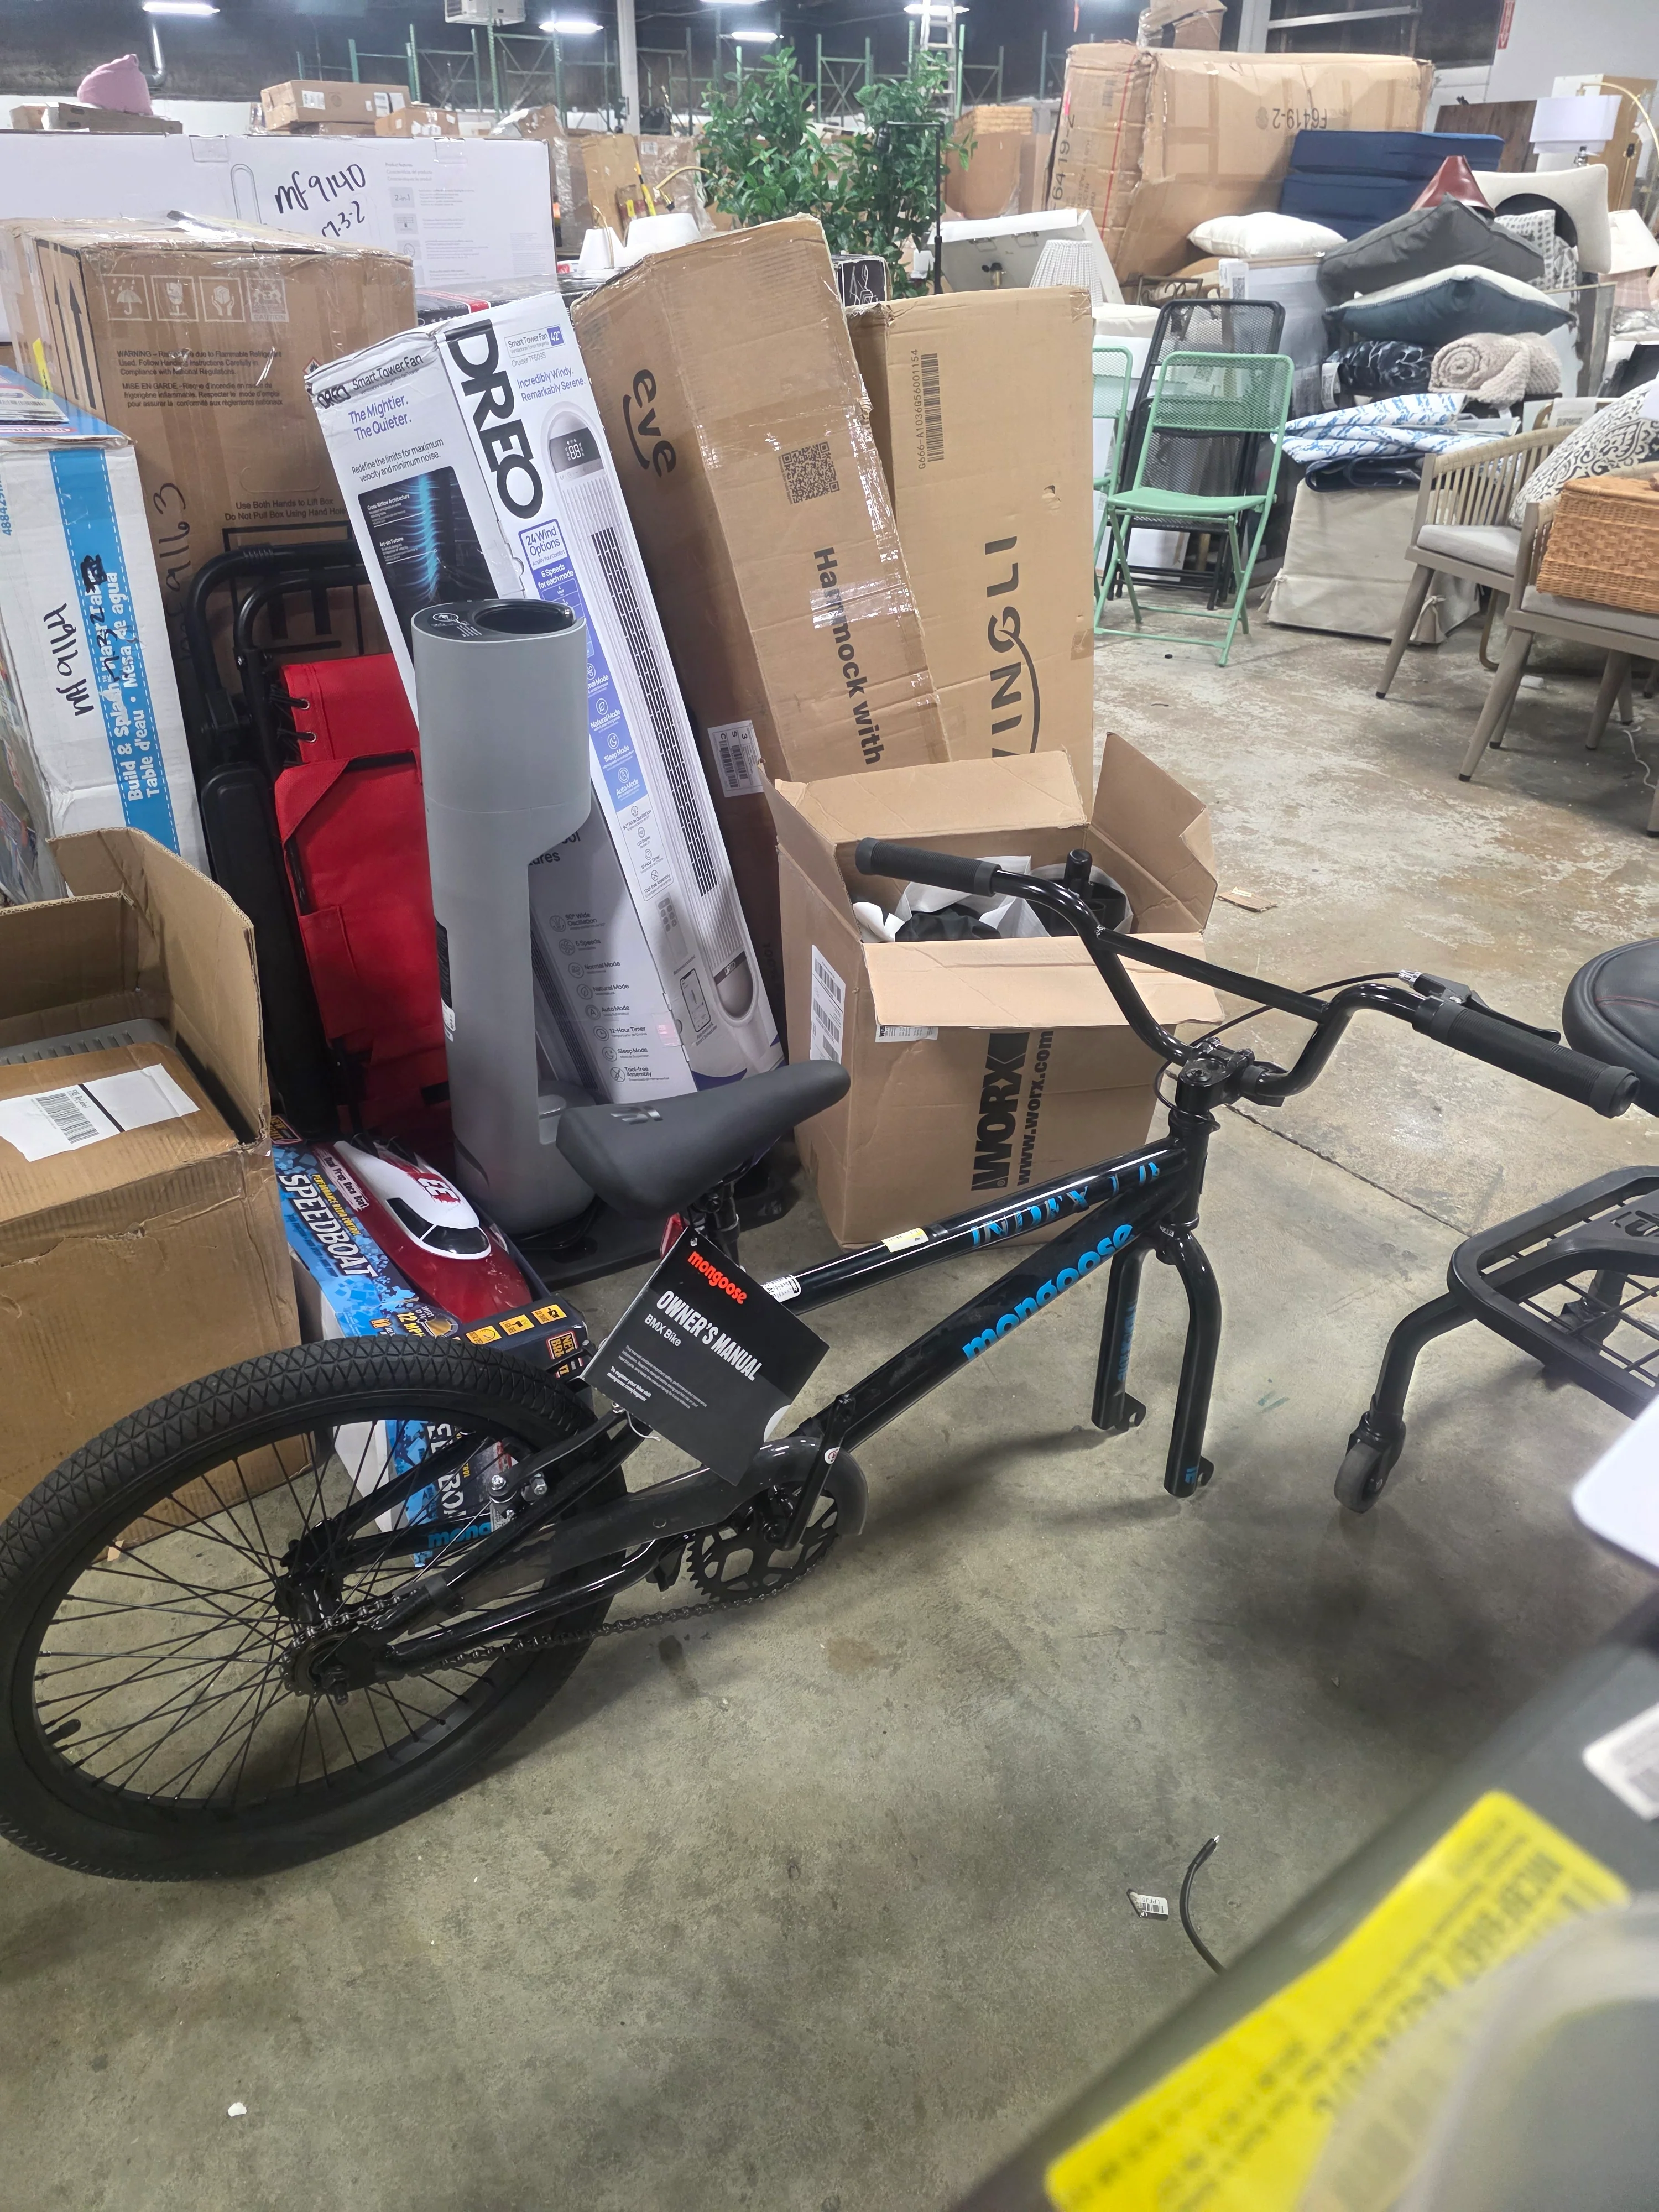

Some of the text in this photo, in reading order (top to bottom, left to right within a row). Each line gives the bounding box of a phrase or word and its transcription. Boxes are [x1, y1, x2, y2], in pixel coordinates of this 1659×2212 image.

[508, 337, 523, 348] Smart
[523, 335, 540, 345] Tower
[539, 333, 549, 342] Fan
[120, 368, 158, 377] Compliance
[225, 359, 252, 368] Carefully
[352, 372, 378, 390] Smart
[377, 362, 405, 378] Tower
[404, 354, 424, 370] Fan
[511, 356, 529, 367] Cruiser
[516, 366, 575, 389] Incredibly Windy.
[520, 377, 586, 403] Remarkably Serene.
[348, 395, 409, 425] The Mightier.
[444, 318, 544, 519] DREO
[353, 412, 413, 441] The Quieter.
[351, 438, 445, 474] Redefine the limits for maximum
[359, 450, 442, 483] velocity and minimum noise.
[225, 507, 346, 521] Do Not Pull Box Using Hand Hole
[236, 502, 251, 510] Use
[253, 500, 271, 509] Both
[272, 499, 297, 509] Hands
[307, 498, 319, 506] Lift
[320, 497, 334, 505] Box
[525, 526, 557, 546] 24 Wind
[529, 538, 561, 557] Options
[538, 569, 575, 590] for each mode
[545, 563, 566, 577] Speeds
[813, 547, 885, 765] Hammock with
[107, 572, 160, 799] Table d'eau Mesa de agua
[596, 674, 609, 685] Mode
[590, 714, 609, 729] Natural
[607, 709, 620, 720] Mode
[117, 743, 133, 755] &
[604, 752, 618, 763] Sleep
[616, 745, 630, 756] Mode
[120, 760, 143, 801] Build
[615, 785, 627, 796] Auto
[625, 779, 639, 790] Mode
[971, 1032, 1030, 1191] WORX
[1016, 1030, 1054, 1186] www.worx.com
[332, 1168, 346, 1183] Prop
[342, 1181, 357, 1196] Race
[353, 1193, 368, 1209] Boat
[311, 1174, 361, 1237] PERFORMANCE RADIO CONTROL
[278, 1174, 379, 1278] SPEEDBOAT
[687, 1250, 748, 1305] mongoose
[962, 1223, 1134, 1361] mongoose
[397, 1312, 418, 1323] 12
[644, 1313, 681, 1347] BMX Bike
[656, 1290, 763, 1381] OWNER'S MANUAL
